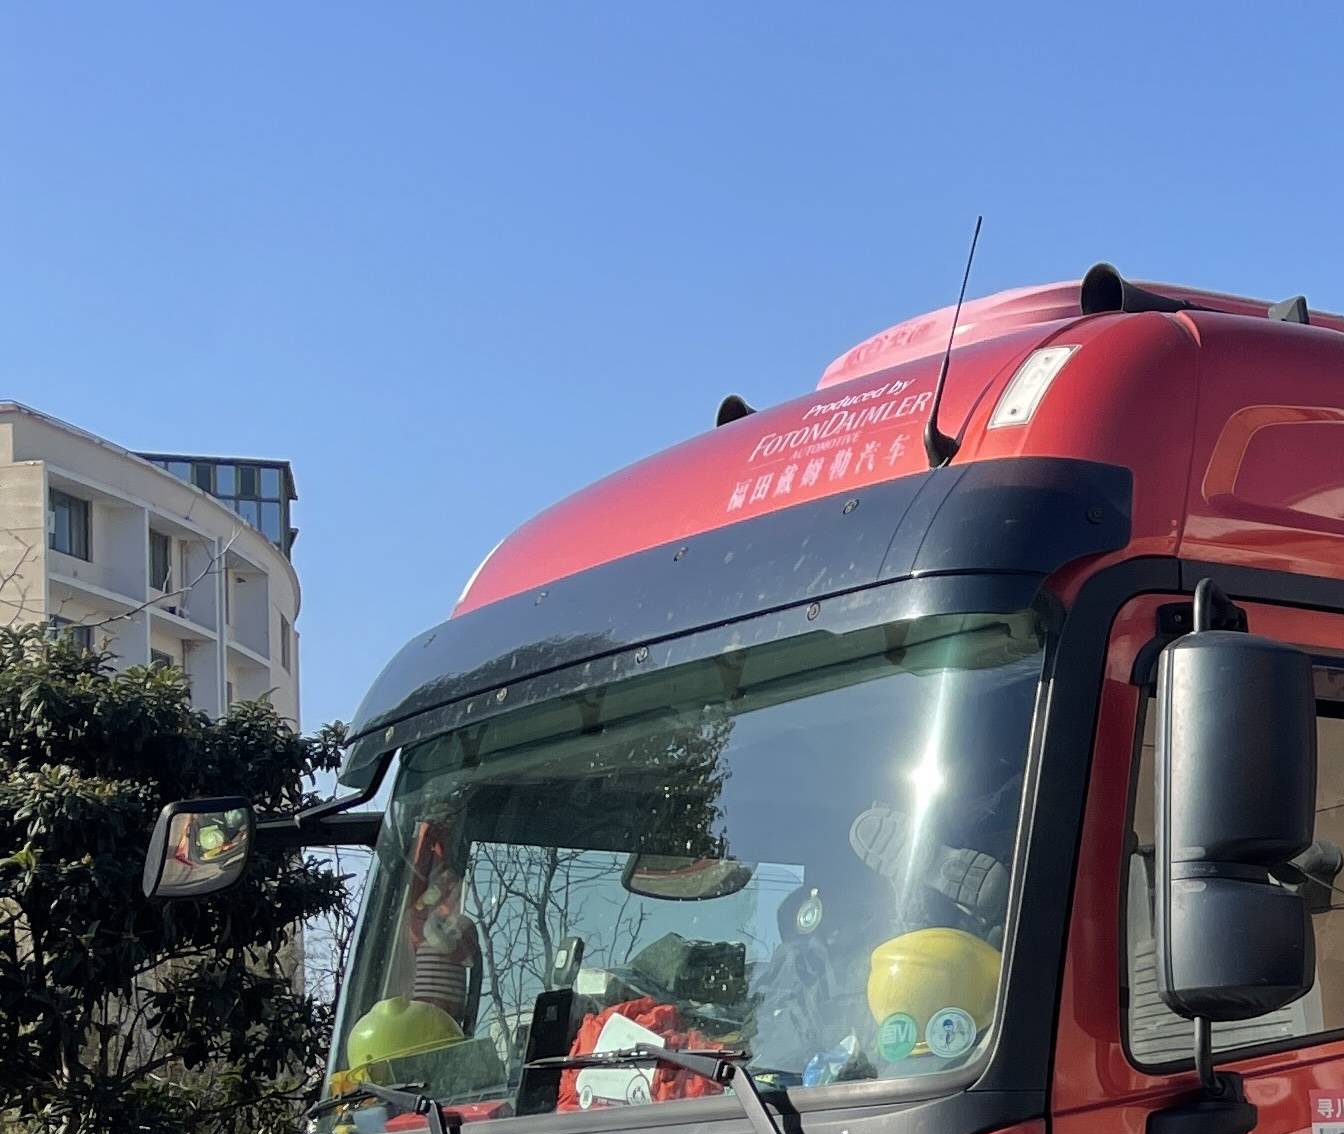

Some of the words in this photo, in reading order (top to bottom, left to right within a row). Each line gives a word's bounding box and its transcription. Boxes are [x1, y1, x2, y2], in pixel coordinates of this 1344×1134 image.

[803, 387, 892, 420] Produced
[891, 378, 916, 396] by
[789, 434, 859, 461] AUTOMOTIVE
[726, 435, 912, 512] 福田戴姆勒汽车
